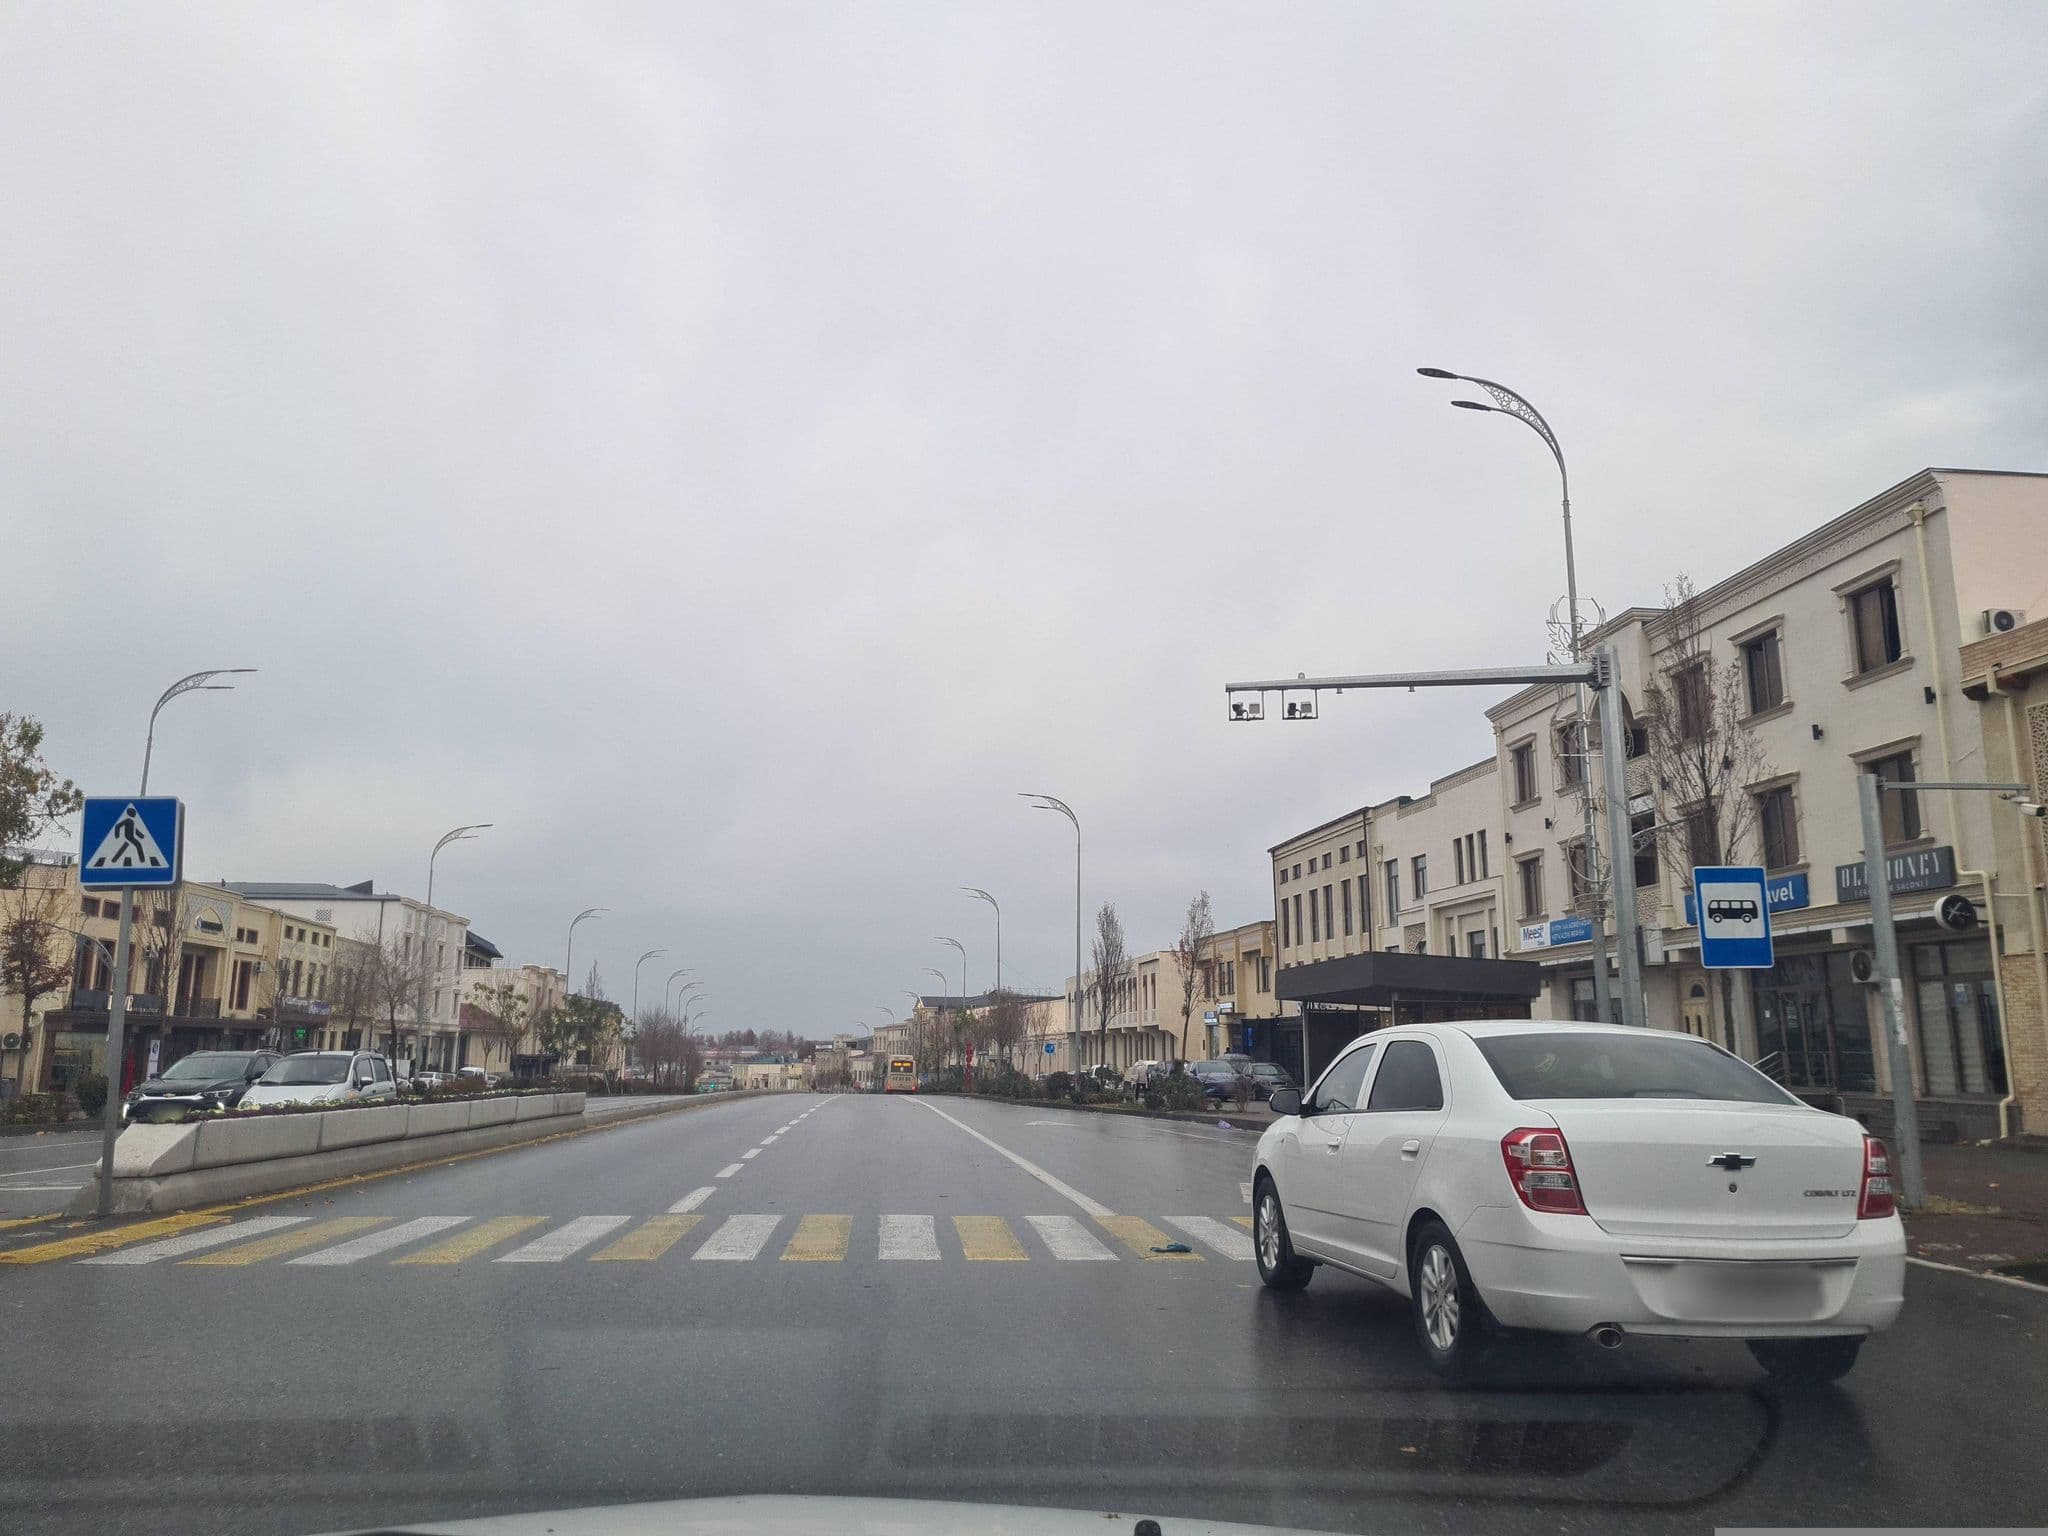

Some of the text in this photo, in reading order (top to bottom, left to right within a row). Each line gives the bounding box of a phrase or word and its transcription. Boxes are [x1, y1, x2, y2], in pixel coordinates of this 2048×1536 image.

[1841, 852, 1940, 888] OL ONEY
[1767, 881, 1795, 904] avel
